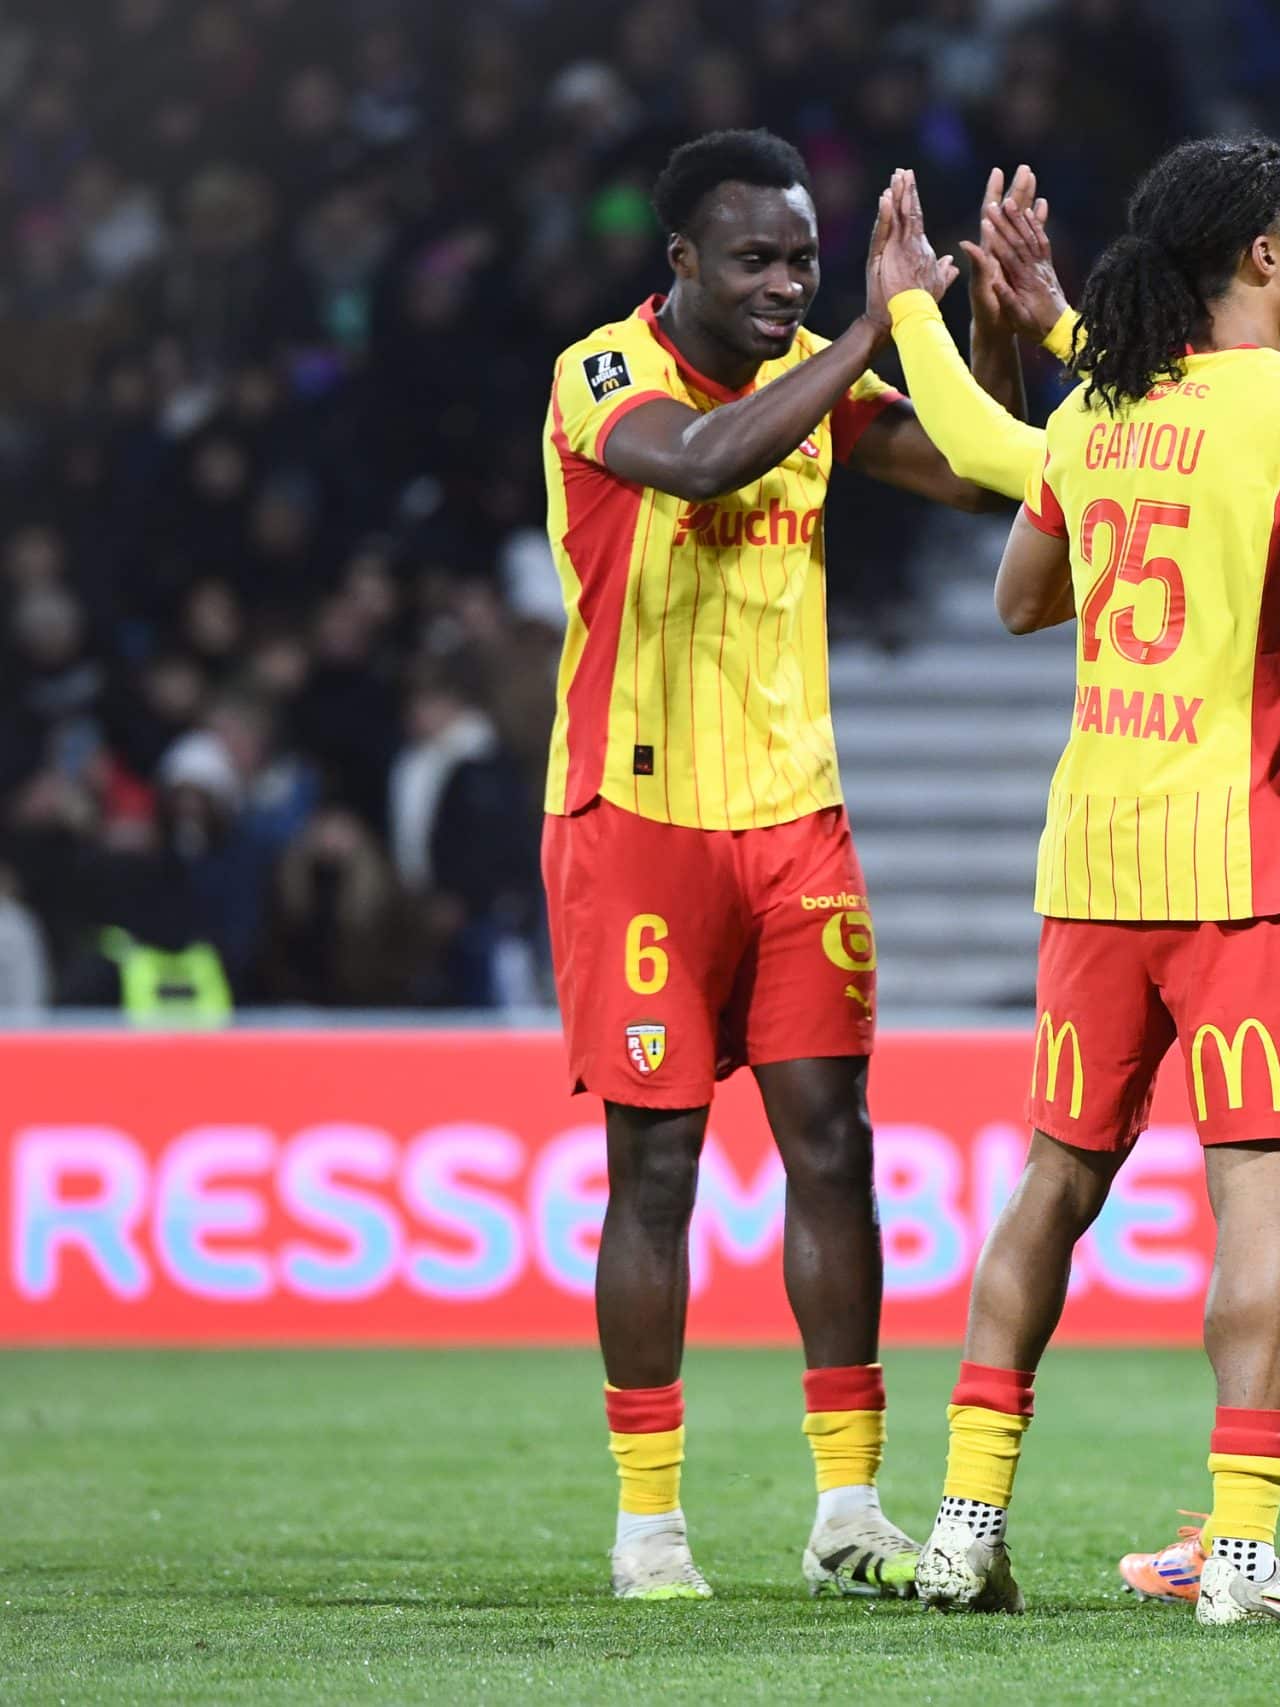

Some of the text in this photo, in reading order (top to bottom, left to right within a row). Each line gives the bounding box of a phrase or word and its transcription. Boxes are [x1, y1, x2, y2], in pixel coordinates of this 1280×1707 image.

[1086, 422, 1206, 475] GANIOU
[1080, 498, 1191, 665] 25
[625, 914, 669, 995] 6
[628, 1037, 650, 1071] RCL
